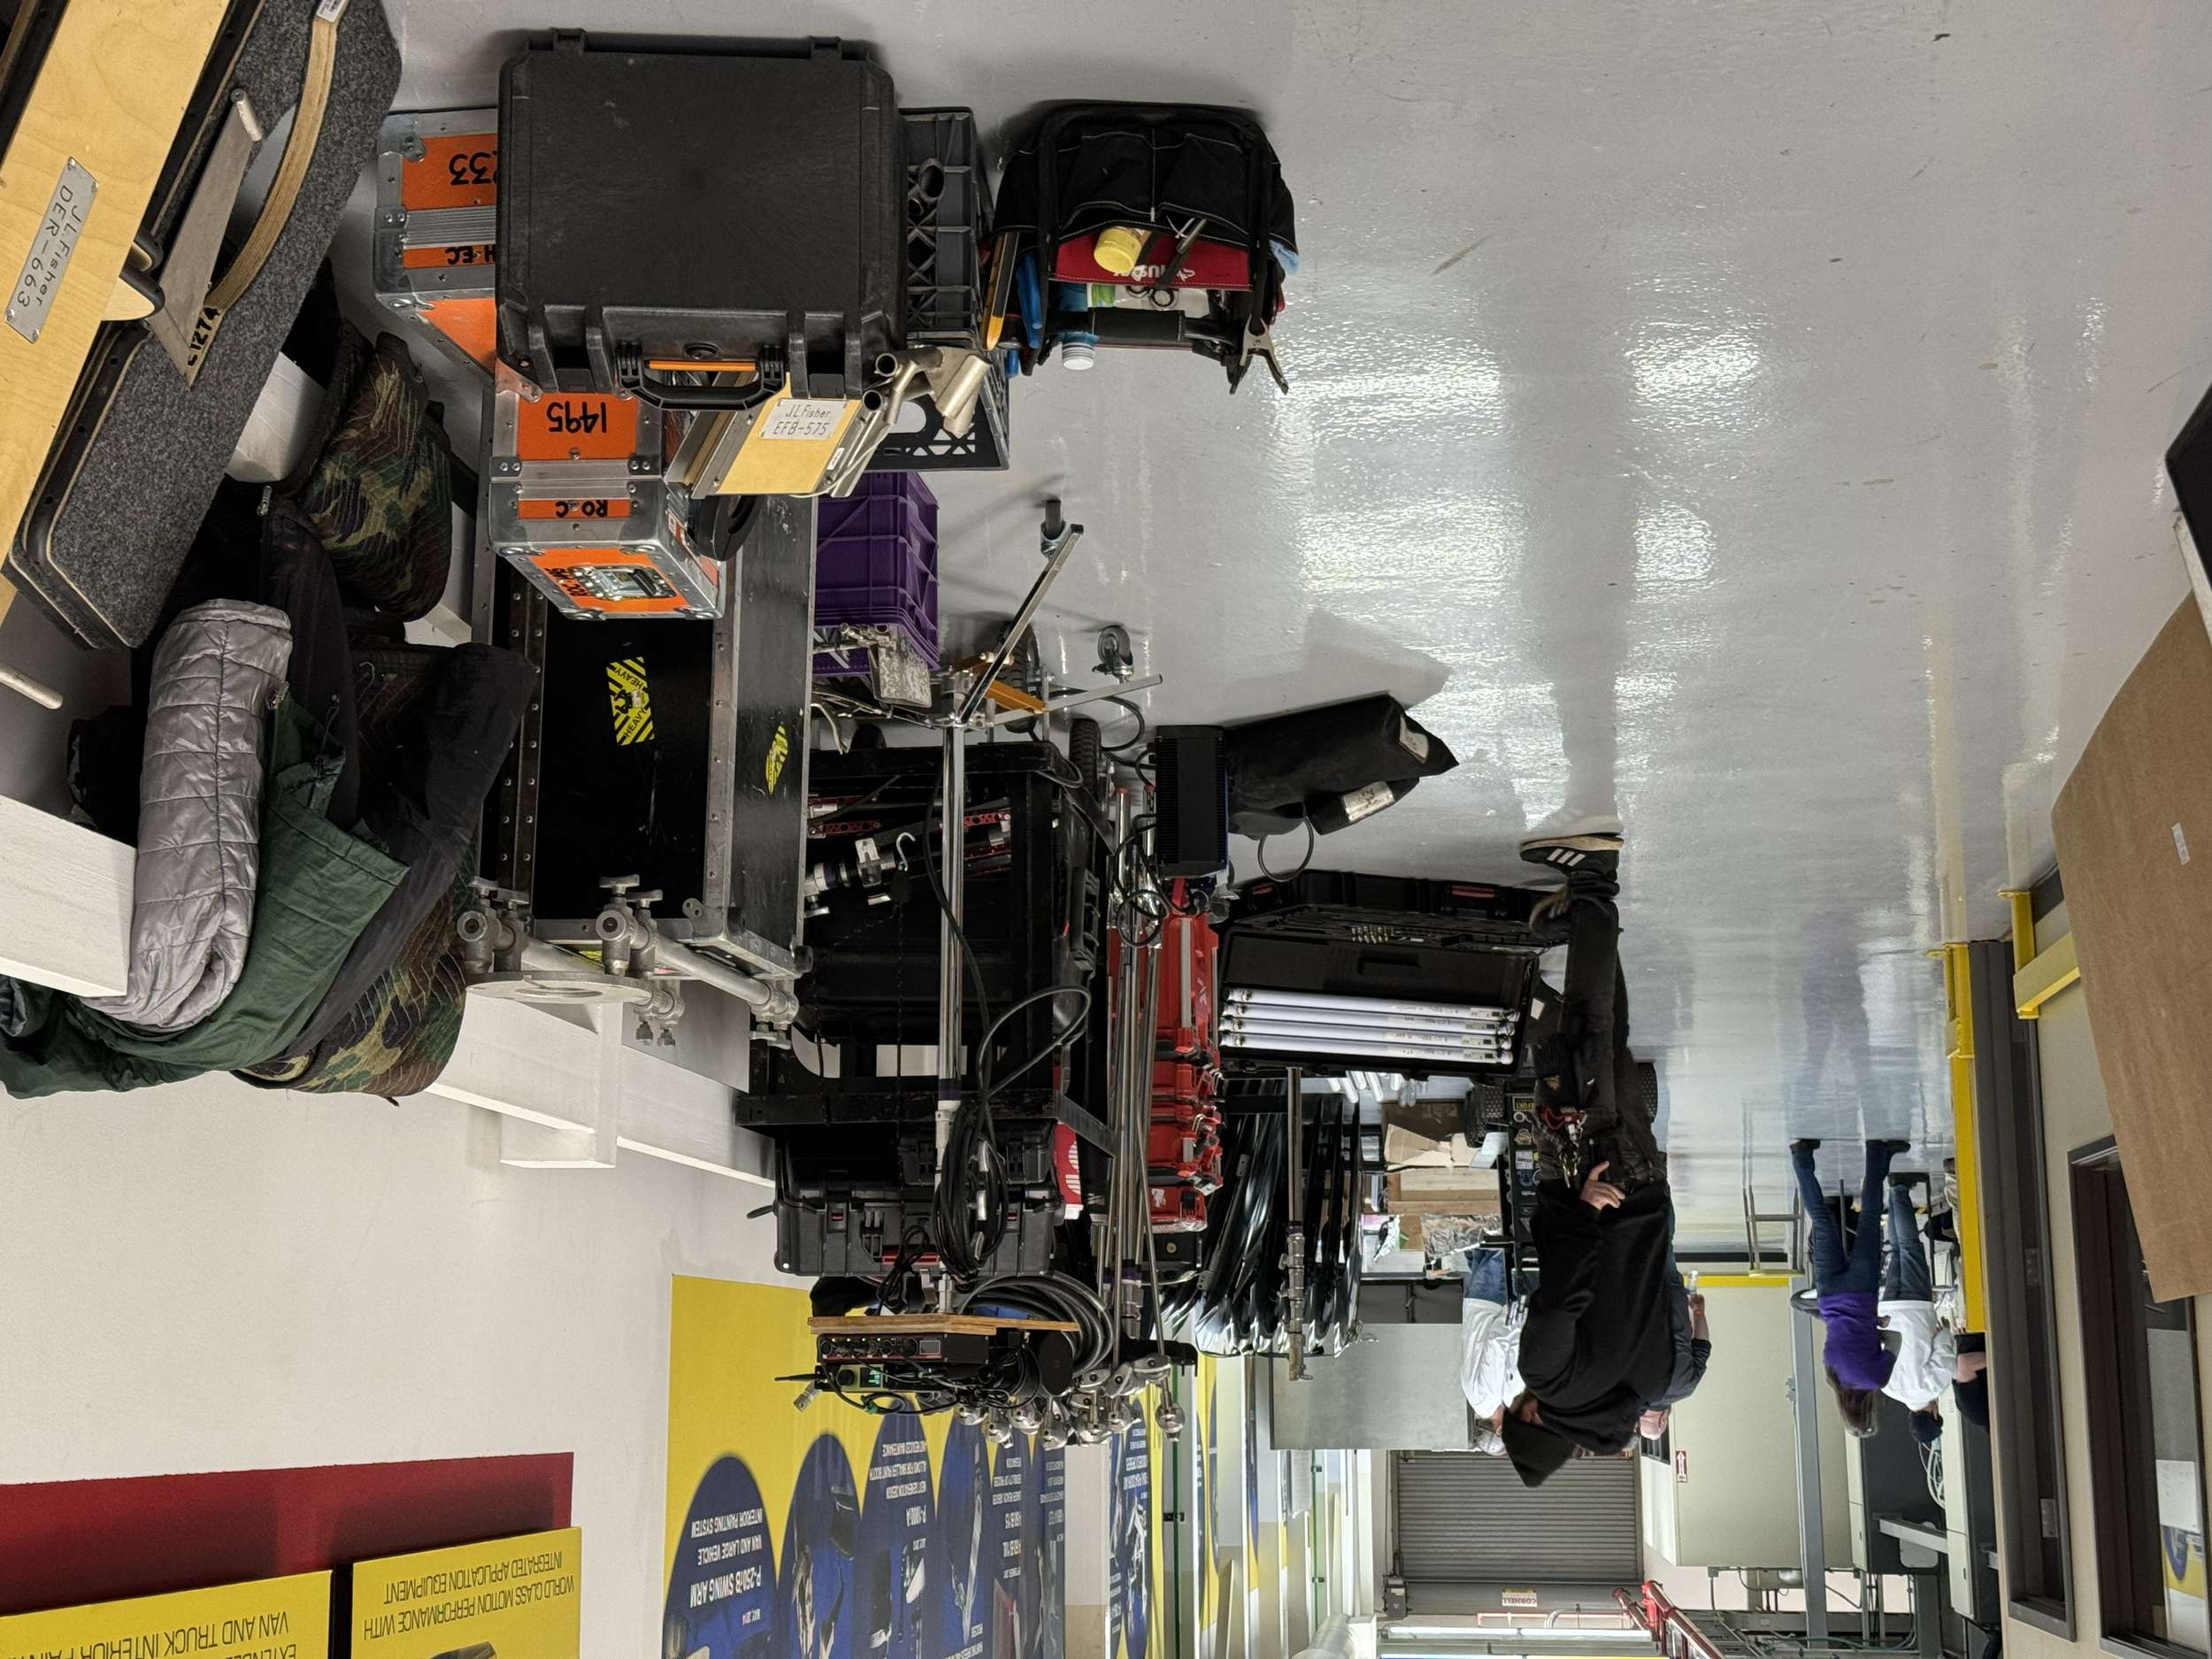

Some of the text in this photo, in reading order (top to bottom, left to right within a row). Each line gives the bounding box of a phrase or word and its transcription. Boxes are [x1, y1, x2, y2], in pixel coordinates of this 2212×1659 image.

[547, 401, 607, 434] 1495
[773, 421, 829, 435] EFB-575
[612, 667, 644, 690] HEAVY
[623, 708, 646, 738] HEAVY
[691, 1508, 763, 1539] INTERIOR PAINTING SYSTEM
[698, 1544, 720, 1566] VEHICLE
[722, 1540, 739, 1559] LARGE
[740, 1536, 751, 1554] AND
[384, 1550, 563, 1605] INTEGRATED APPLICATION EQUIPMENT
[709, 1572, 734, 1602] SWING
[364, 1575, 574, 1641] WORLD CLASS MOTION PERFORMANCE WITH
[690, 1580, 708, 1609] ARM
[221, 1616, 255, 1645] AND
[258, 1610, 289, 1639] VAN
[164, 1623, 218, 1657] TRUCK
